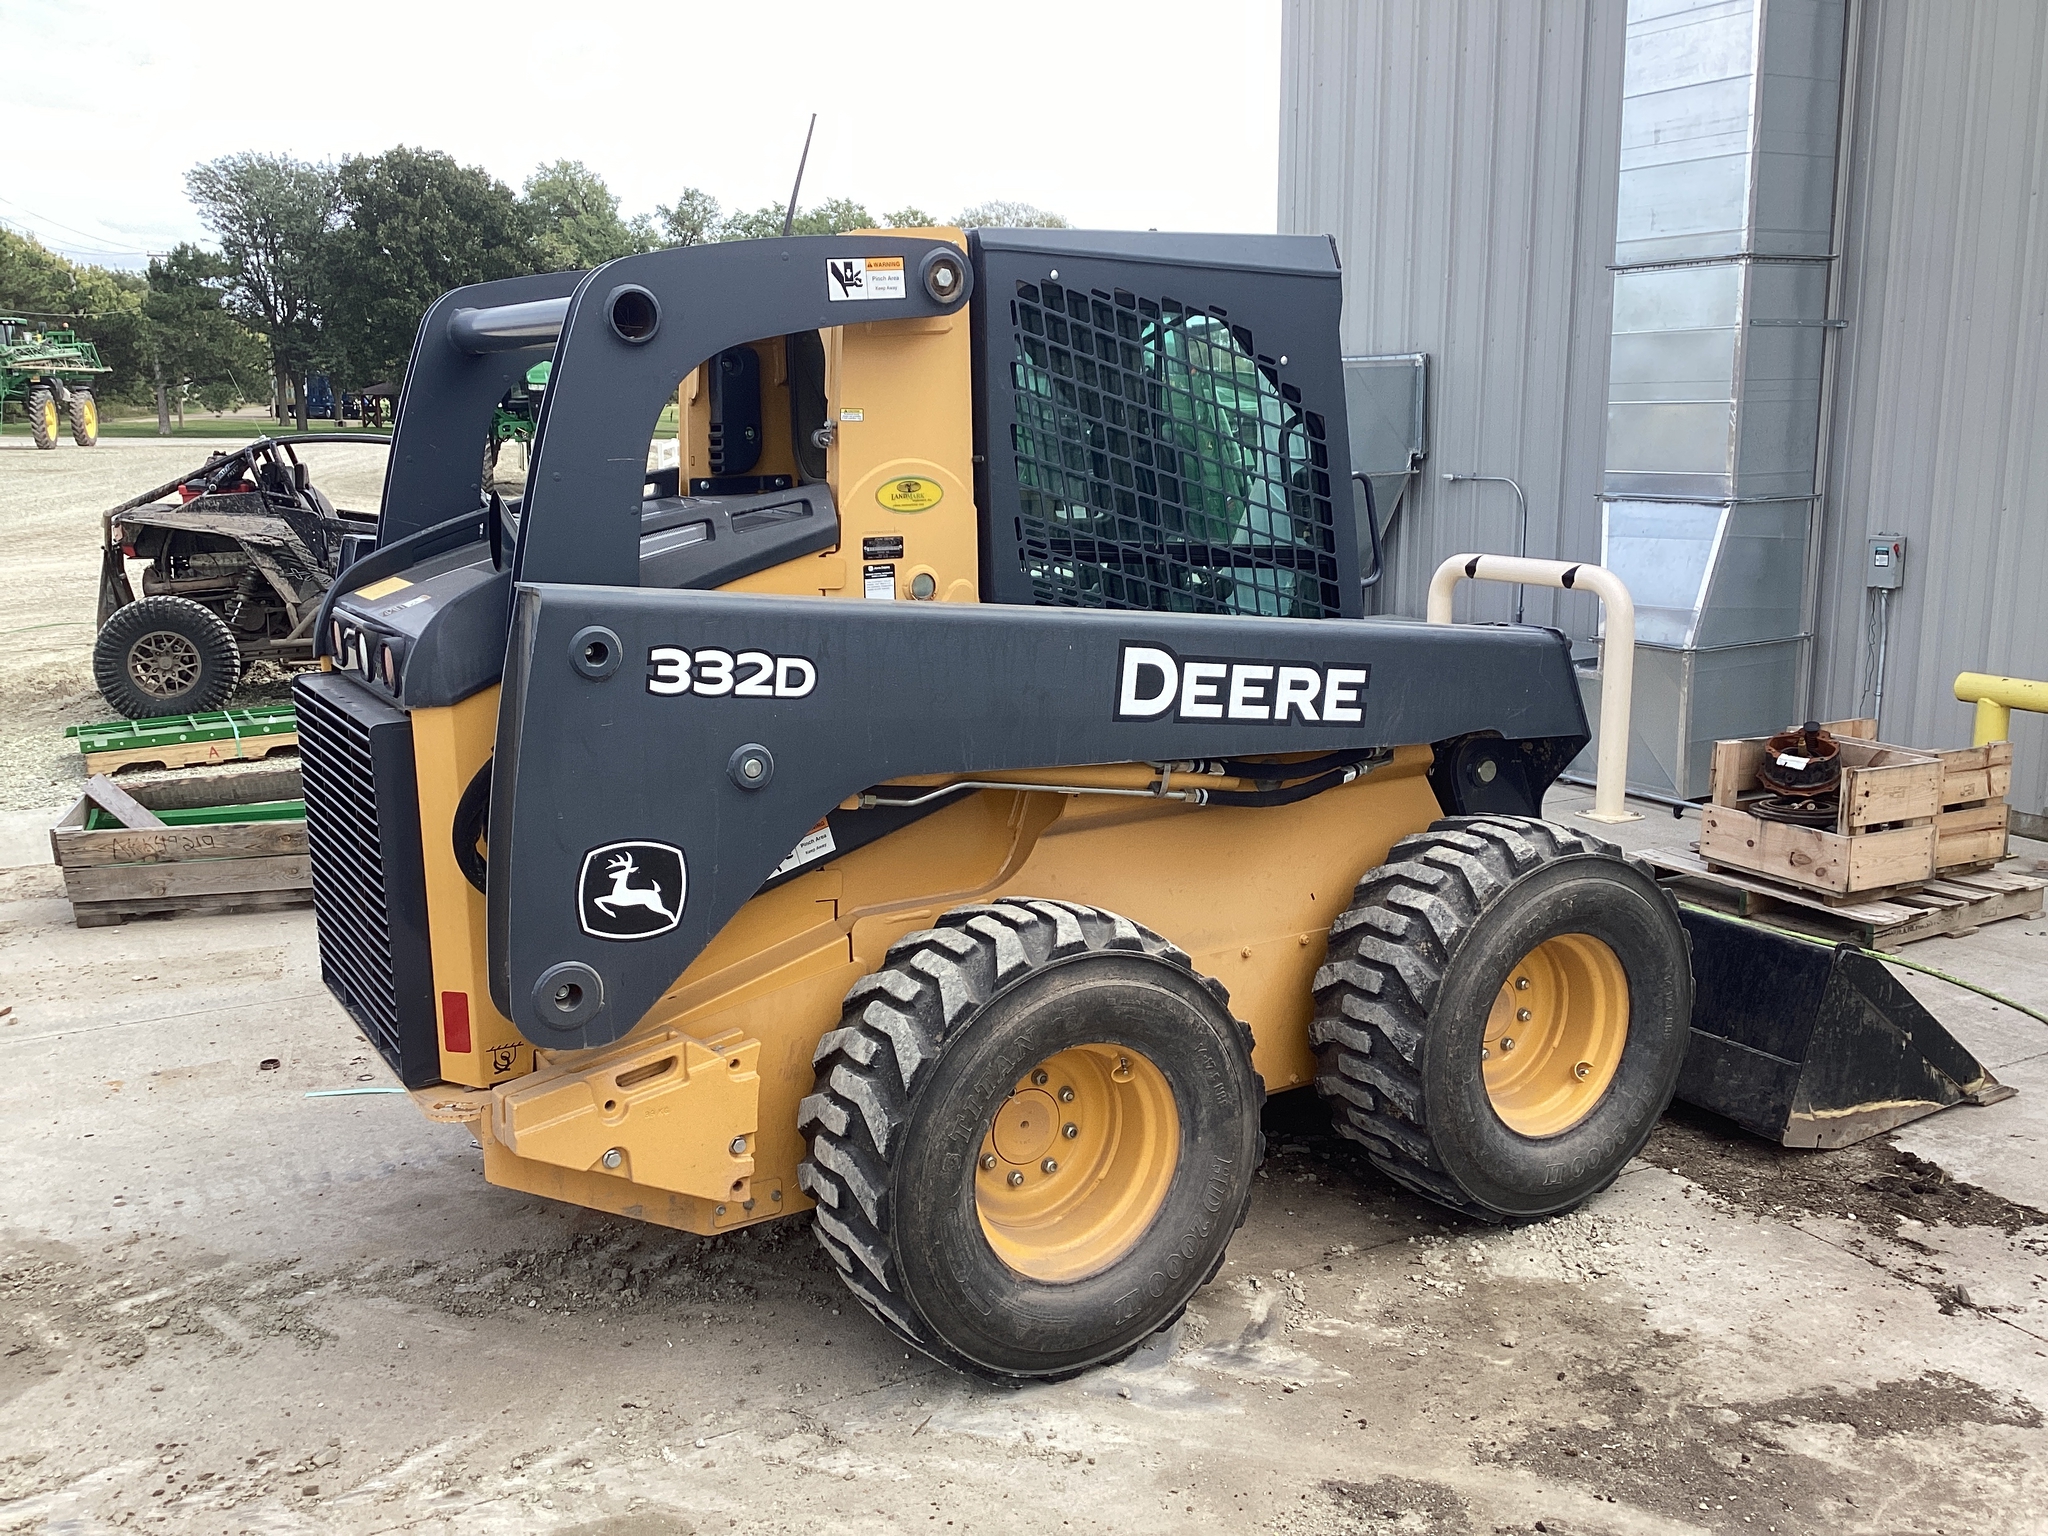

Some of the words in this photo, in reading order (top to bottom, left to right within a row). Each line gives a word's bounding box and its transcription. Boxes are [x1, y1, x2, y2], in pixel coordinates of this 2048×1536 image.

[891, 493, 925, 501] LANDMARK
[648, 646, 817, 698] 332D
[1118, 646, 1368, 722] DEERE
[209, 746, 219, 758] A
[801, 840, 815, 848] Pinch
[805, 847, 816, 855] Keep
[947, 1024, 1037, 1144] TITAN
